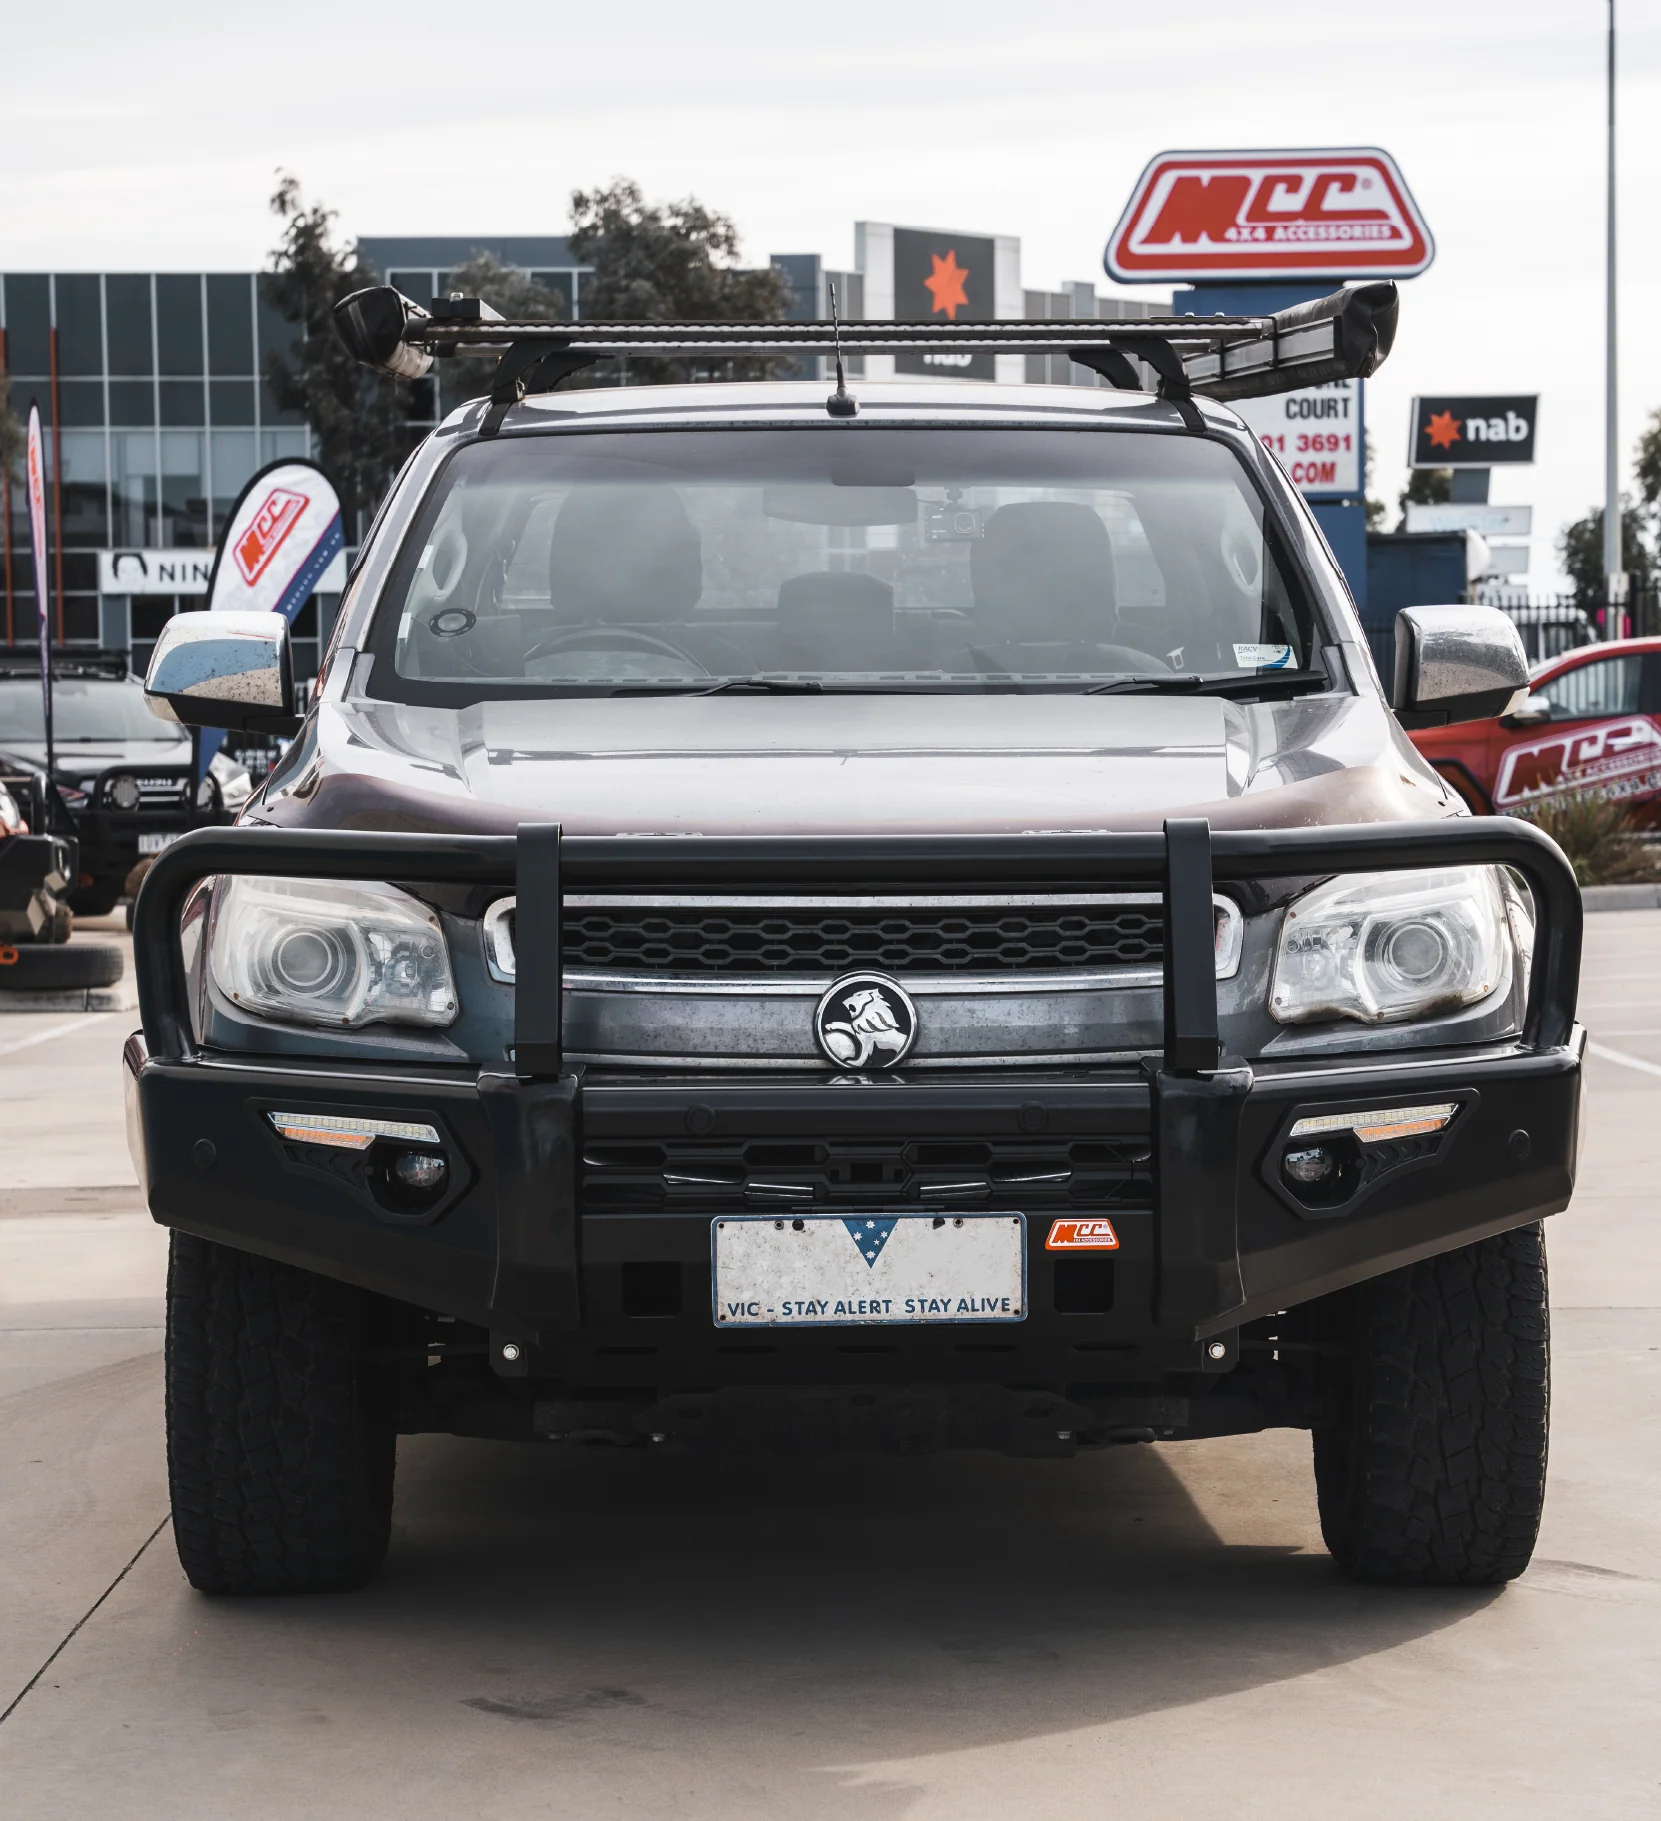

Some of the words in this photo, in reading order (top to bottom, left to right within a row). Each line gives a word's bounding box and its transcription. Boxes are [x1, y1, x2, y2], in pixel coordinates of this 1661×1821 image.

[1139, 173, 1391, 245] MCC
[1224, 226, 1267, 242] 4X4
[1273, 224, 1392, 241] ACCESSORIES
[1285, 397, 1350, 420] COURT
[1466, 410, 1529, 442] nab
[1296, 433, 1352, 453] 3691
[1052, 1224, 1111, 1243] MCC
[727, 1302, 759, 1317] VIC
[782, 1301, 828, 1316] STAY
[834, 1300, 893, 1315] ALERT
[905, 1298, 950, 1313] STAY
[957, 1297, 1010, 1313] ALIVE
